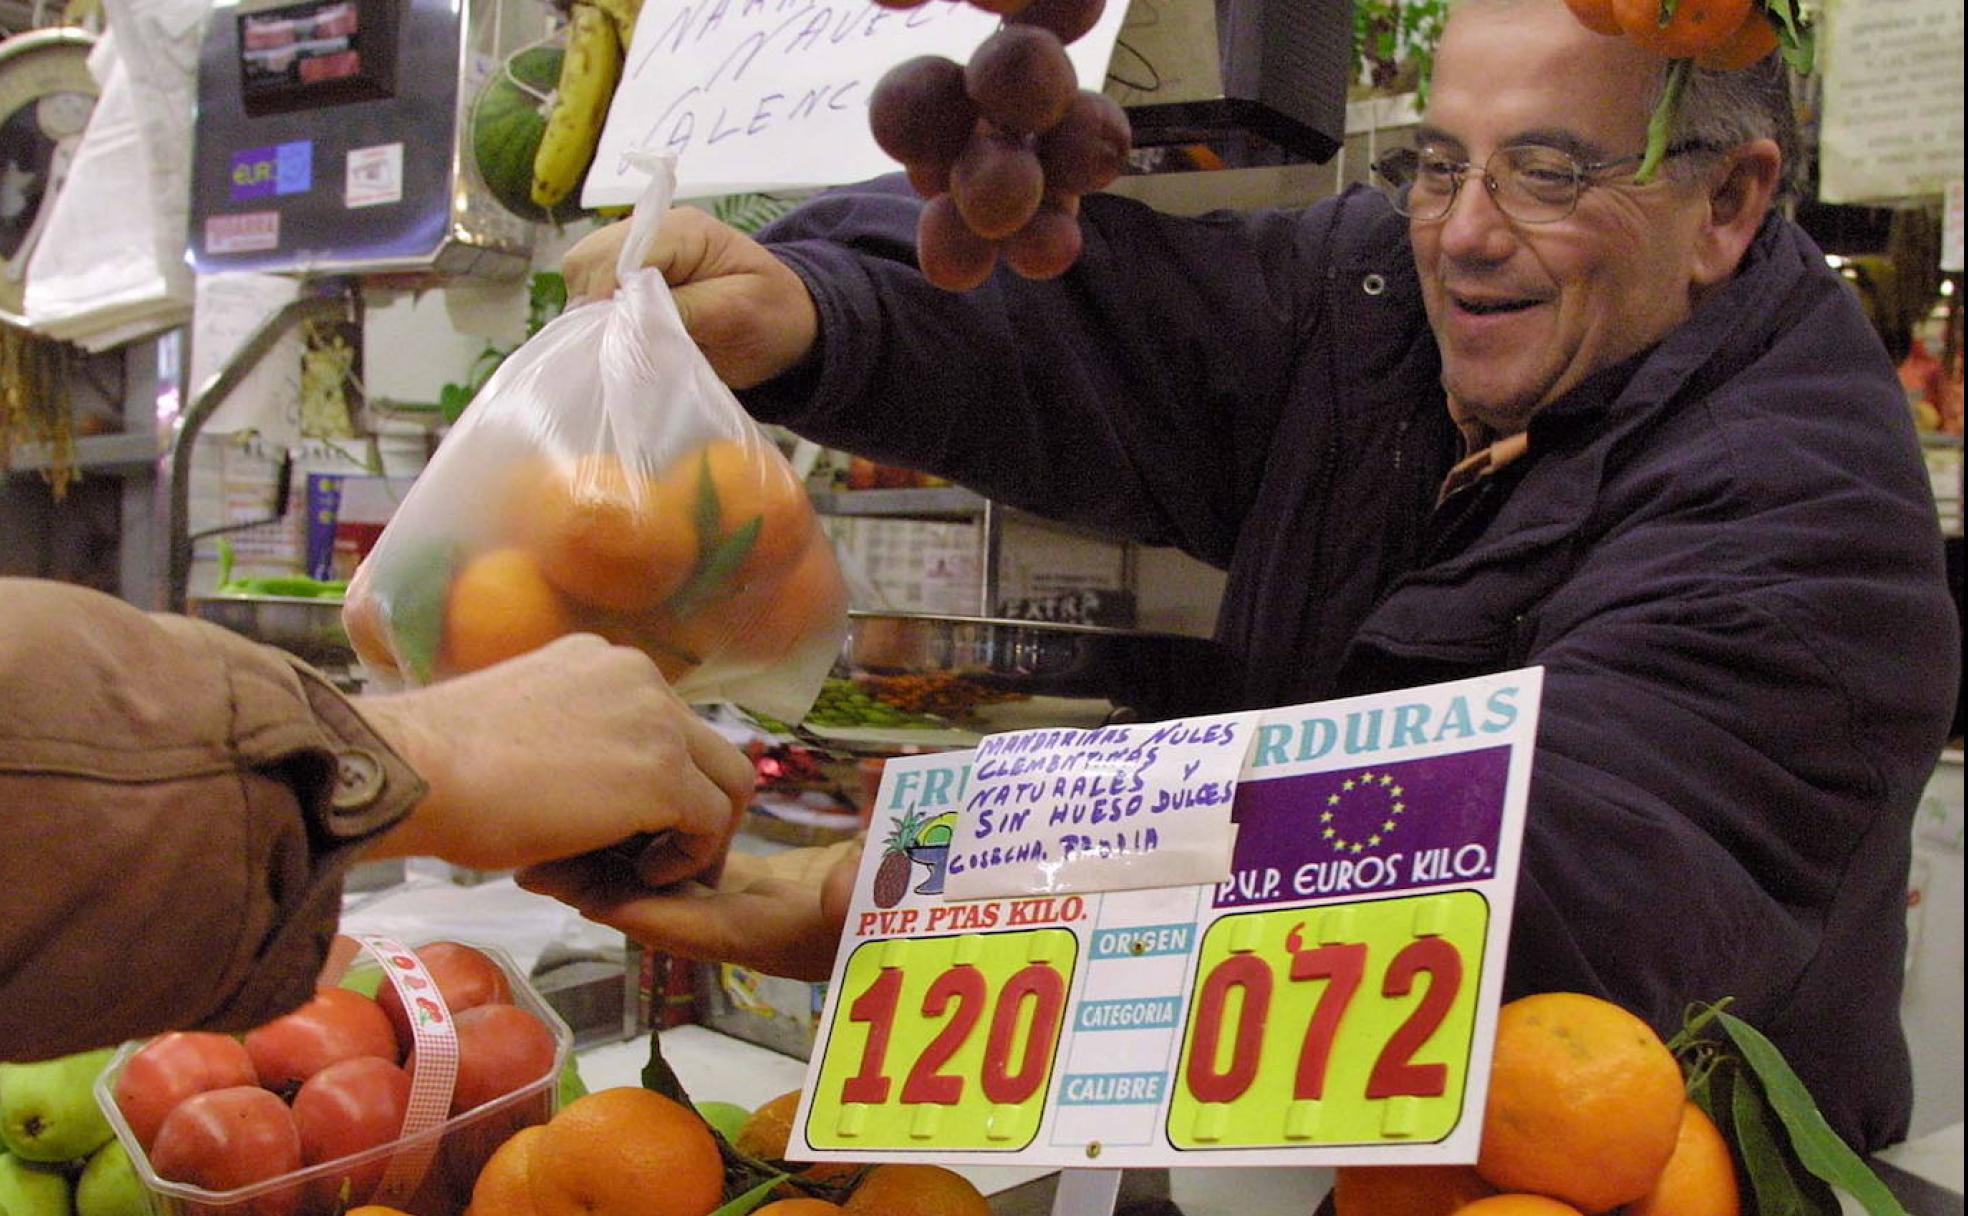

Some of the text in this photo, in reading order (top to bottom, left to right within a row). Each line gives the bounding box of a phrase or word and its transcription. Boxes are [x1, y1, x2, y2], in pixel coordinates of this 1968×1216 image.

[617, 80, 870, 175] VALENC
[976, 722, 1239, 763] MANDARINAS NULES
[1252, 687, 1520, 768] RDURAS
[966, 770, 1145, 812] NATURALES
[975, 780, 1233, 839] SIN HUESO DULCES
[1217, 843, 1492, 902] P.V.P. EUROS KILO.
[856, 896, 1087, 936] P.V.P. PTAS KILO.
[841, 964, 1064, 1105] 120
[1082, 1002, 1174, 1027] CATEGORIA
[1067, 1076, 1159, 1101] CALIBRE
